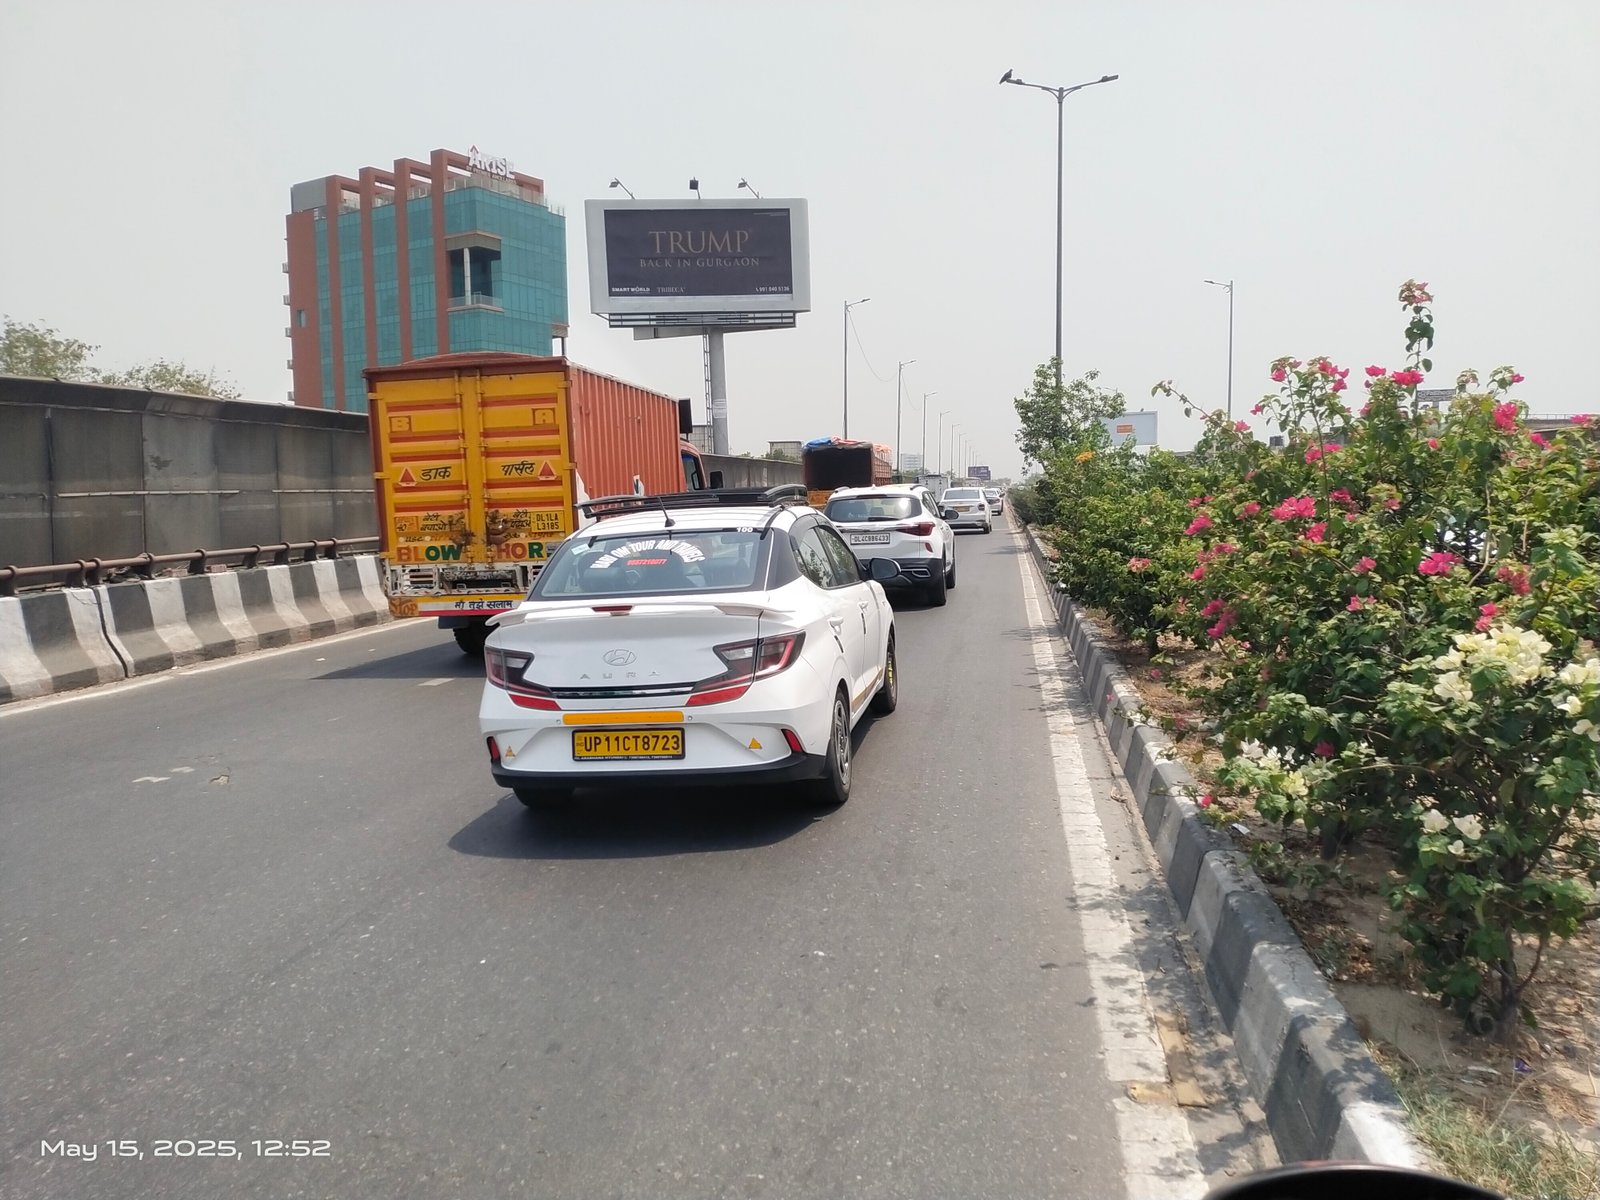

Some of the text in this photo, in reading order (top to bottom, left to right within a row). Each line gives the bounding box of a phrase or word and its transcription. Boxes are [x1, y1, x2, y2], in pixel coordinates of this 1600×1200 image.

[649, 230, 749, 254] TRUMP
[640, 256, 760, 268] BACK IN GURGAON
[420, 460, 536, 481] डाक पार्सल
[536, 512, 559, 522] DL1LA
[536, 521, 560, 531] L3185
[396, 544, 462, 562] BLOW
[610, 545, 631, 558] OM
[628, 540, 656, 553] TOUR
[655, 539, 679, 551] AND
[671, 541, 706, 563] TRAVELS
[486, 600, 513, 609] सलाम
[580, 671, 660, 680] AURA
[583, 734, 681, 752] UP11CT8723
